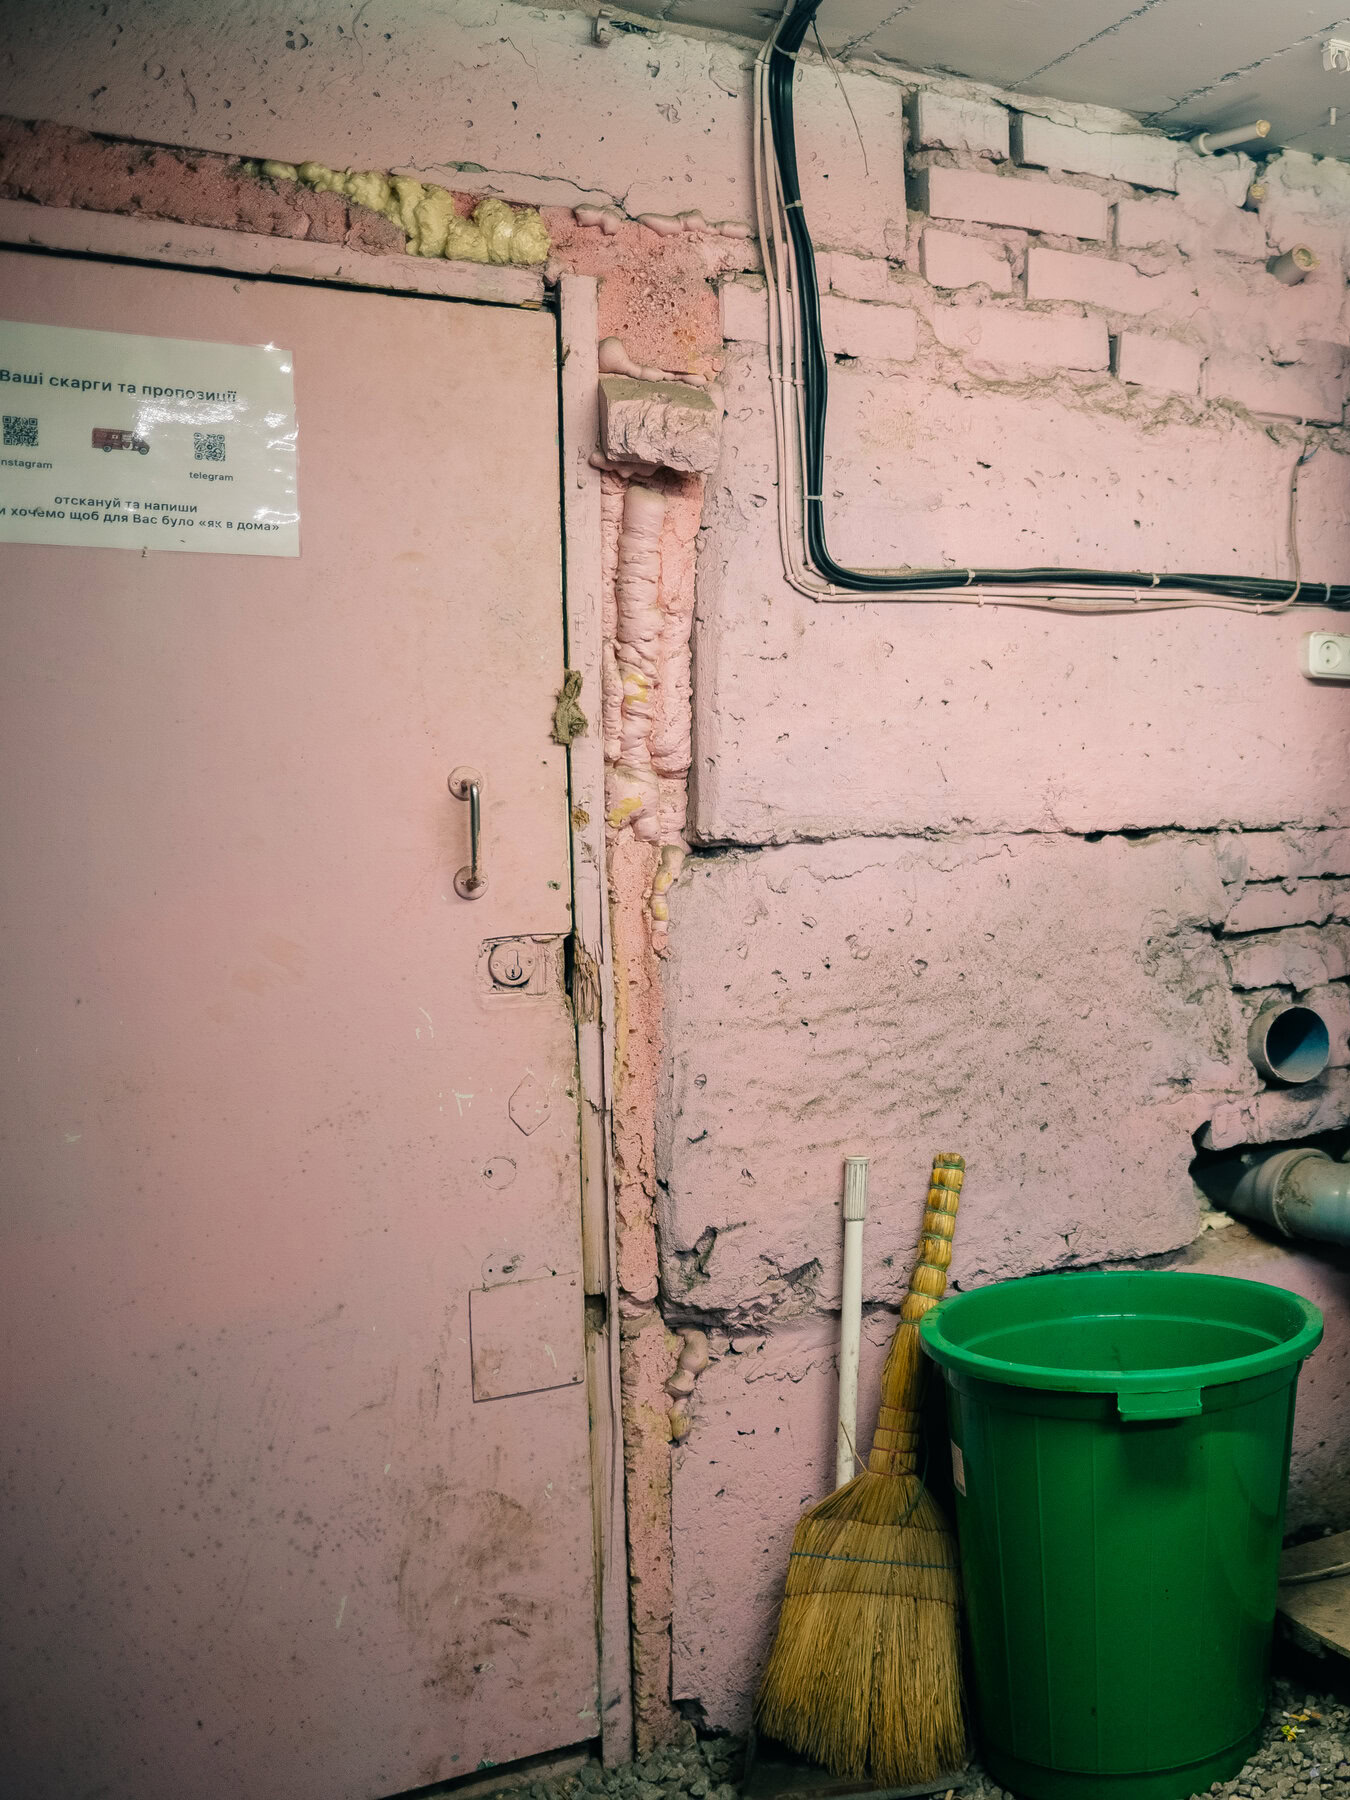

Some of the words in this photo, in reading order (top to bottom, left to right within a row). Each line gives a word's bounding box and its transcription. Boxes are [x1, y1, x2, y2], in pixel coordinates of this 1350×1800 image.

[0, 369, 43, 385] Ваші
[49, 376, 112, 392] скарги
[118, 383, 136, 394] та
[142, 385, 237, 403] пропозиції
[0, 459, 53, 470] nstagram
[189, 471, 234, 482] telegram
[54, 495, 121, 509] отскануй
[125, 501, 140, 509] та
[144, 502, 198, 513] напиши
[11, 507, 65, 519] хочемо
[70, 511, 99, 522] щоб
[103, 514, 128, 523] для
[133, 515, 157, 525] Вас
[162, 515, 194, 528] було
[199, 519, 223, 529] «як
[237, 521, 280, 531] дома»
